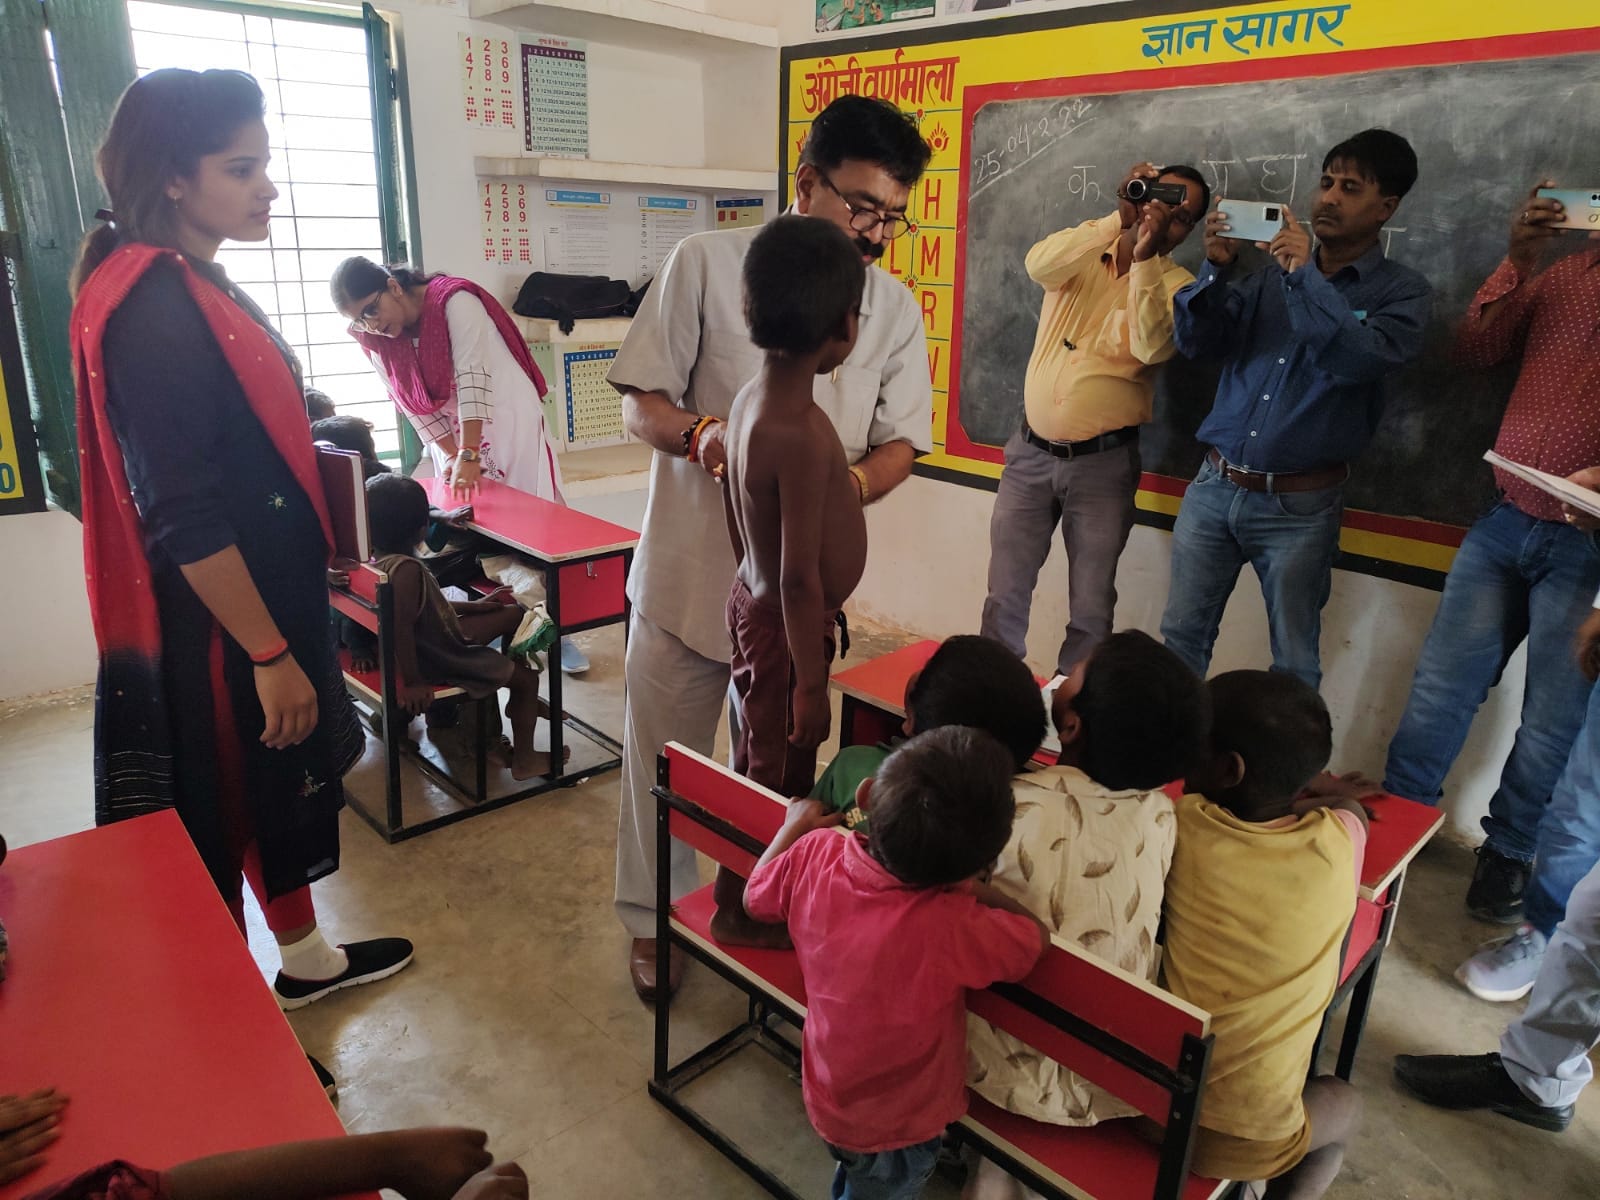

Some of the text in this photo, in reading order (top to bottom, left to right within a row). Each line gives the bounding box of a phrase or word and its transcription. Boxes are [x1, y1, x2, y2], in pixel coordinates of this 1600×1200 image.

[465, 37, 508, 54] 1 2 3
[1142, 4, 1351, 64] ज्ञान सागर
[466, 53, 509, 68] 4 5 6
[466, 67, 509, 82] 7 8 9
[863, 48, 960, 106] वर्णमाला
[485, 183, 525, 195] 1 2 3
[1068, 165, 1100, 201] क
[485, 197, 525, 209] 4 5 6
[924, 179, 941, 220] H
[485, 211, 526, 222] 7 8 9
[890, 236, 940, 277] L M
[922, 291, 936, 331] R
